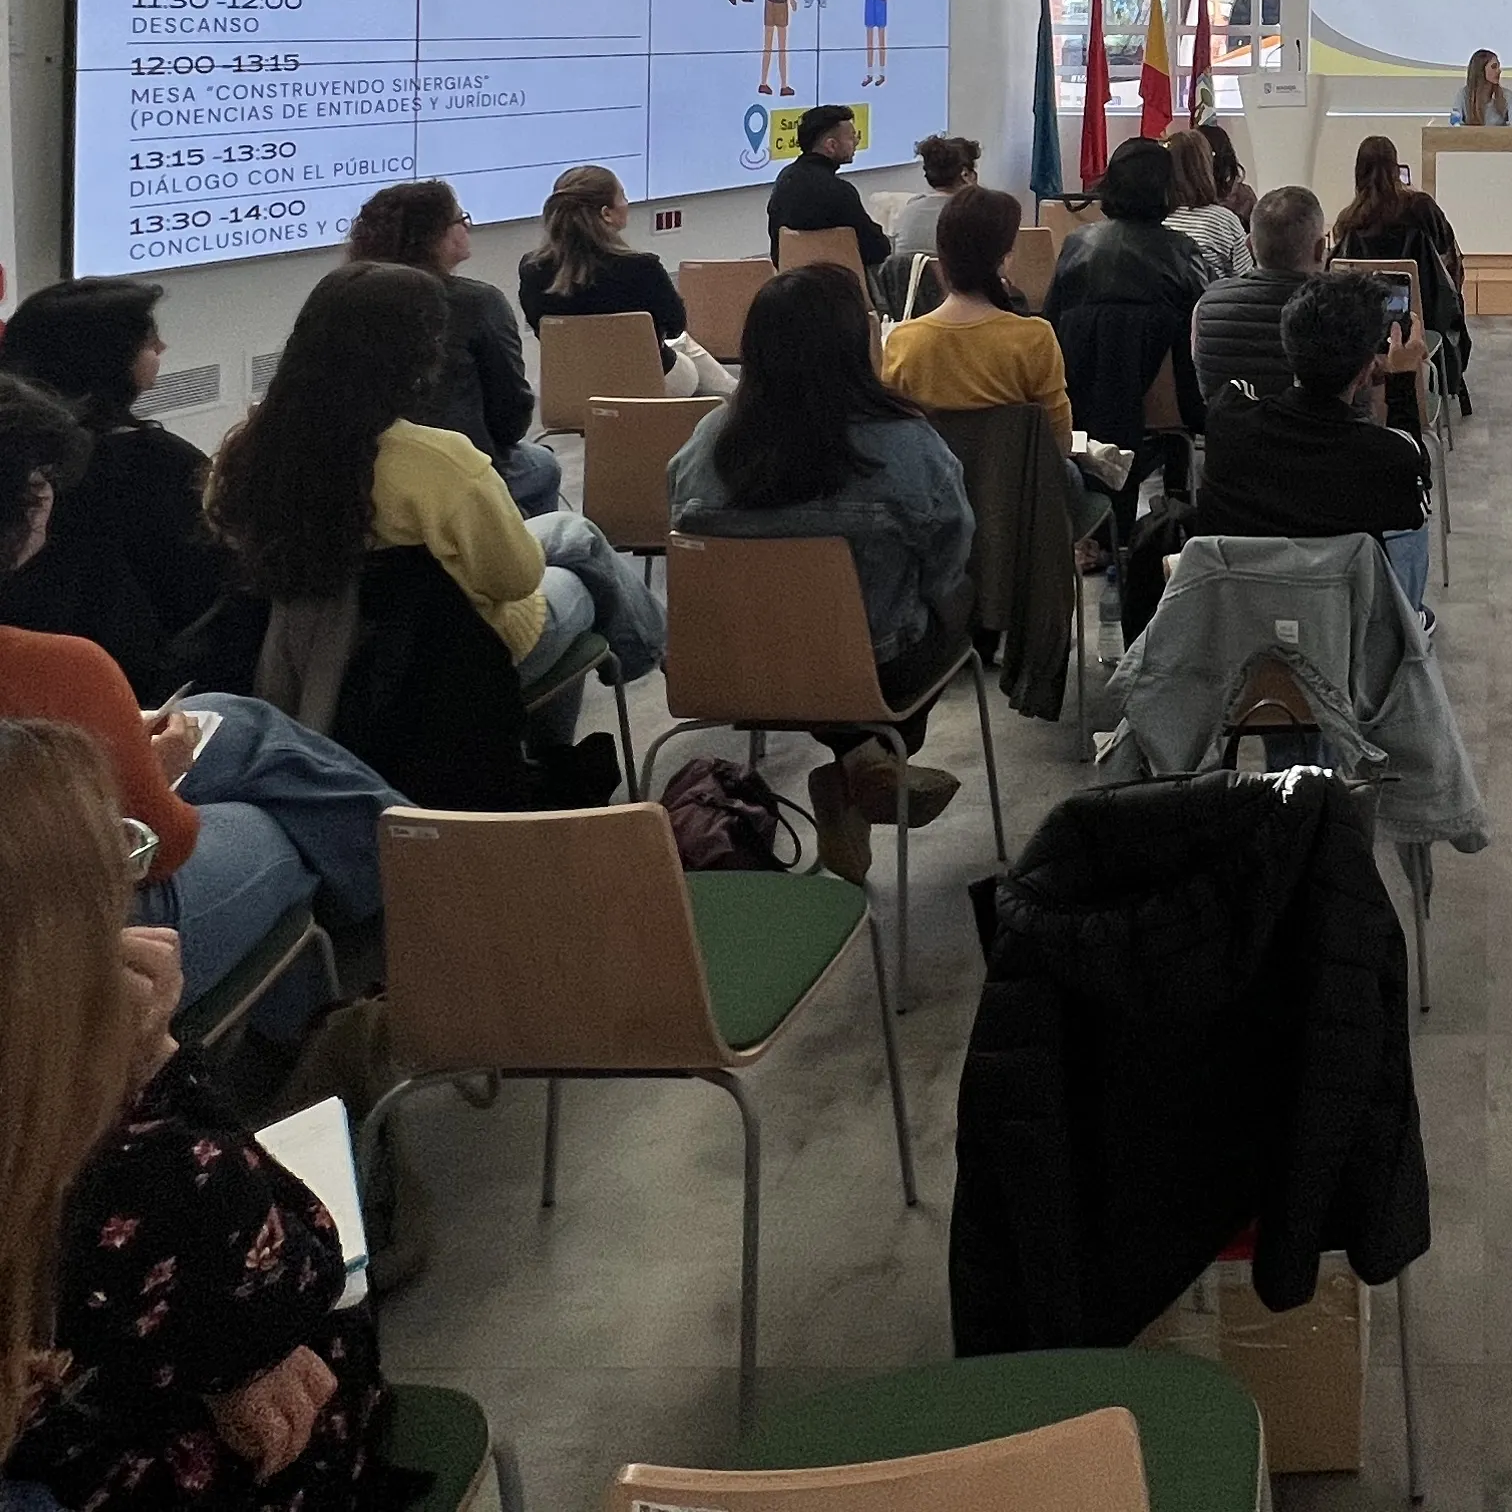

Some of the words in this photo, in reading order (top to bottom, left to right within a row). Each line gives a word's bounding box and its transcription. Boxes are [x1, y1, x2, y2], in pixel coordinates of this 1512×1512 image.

[132, 16, 259, 33] DESCANSO
[131, 56, 215, 76] 12:00
[131, 86, 195, 105] MESA
[130, 105, 273, 130] (PONENCIAS
[283, 103, 308, 121] DE
[316, 96, 422, 118] ENTIDADES
[430, 96, 439, 111] Y
[445, 90, 525, 111] JURÍDICA)
[130, 148, 204, 171] 13:15
[130, 171, 238, 198] DIÁLOGO
[248, 168, 294, 186] CON
[303, 164, 325, 181] EL
[333, 156, 414, 178] PÚBLICO
[130, 211, 210, 236] 13:30
[130, 223, 308, 260] CONCLUSIONES
[317, 220, 327, 238] Y
